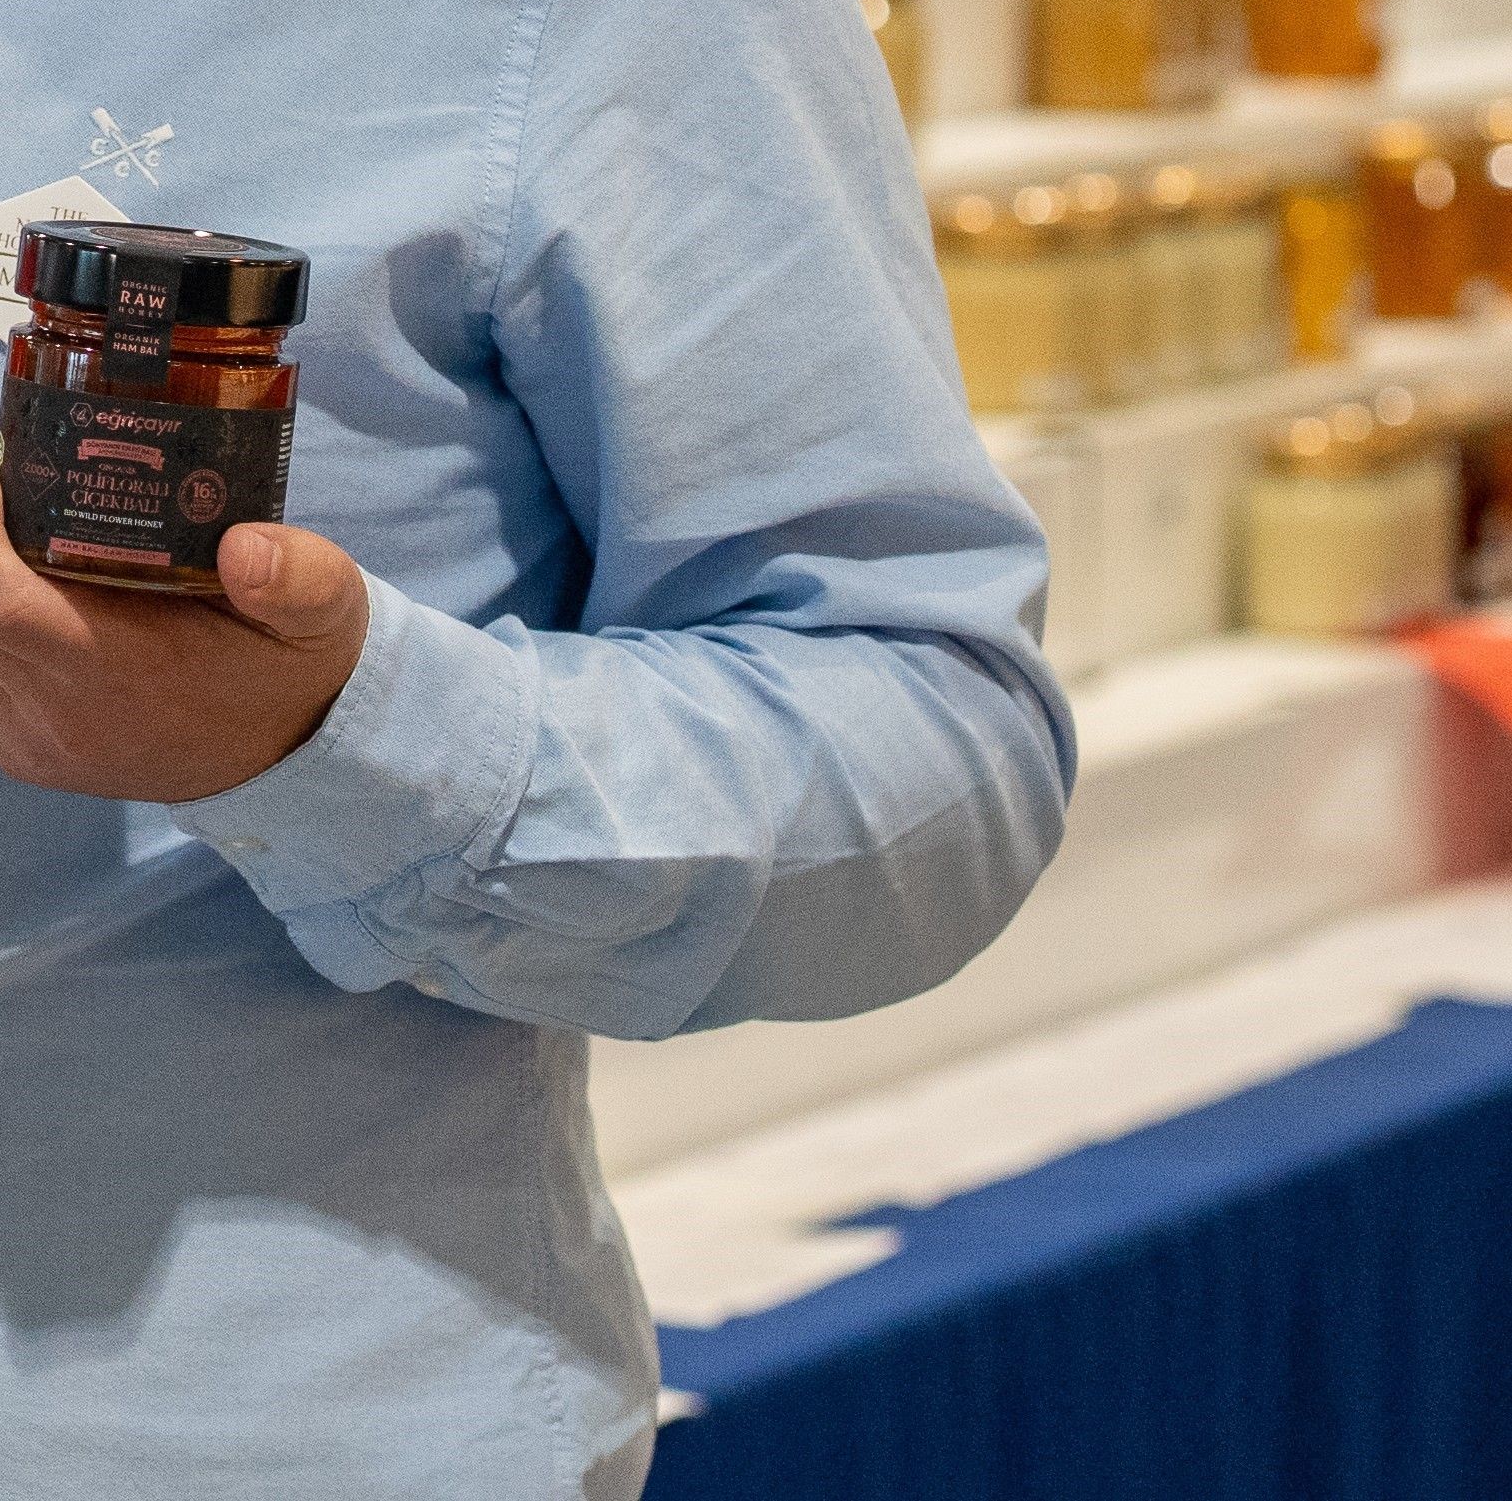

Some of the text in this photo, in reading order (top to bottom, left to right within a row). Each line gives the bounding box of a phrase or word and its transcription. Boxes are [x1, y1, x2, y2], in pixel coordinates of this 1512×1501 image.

[51, 206, 89, 221] THE
[122, 280, 168, 295] ORGANIC
[120, 290, 167, 310] RAW
[118, 306, 164, 319] HONEY
[113, 342, 159, 357] HAM BAL
[63, 508, 165, 530] BIO WILD FLOWER HONEY
